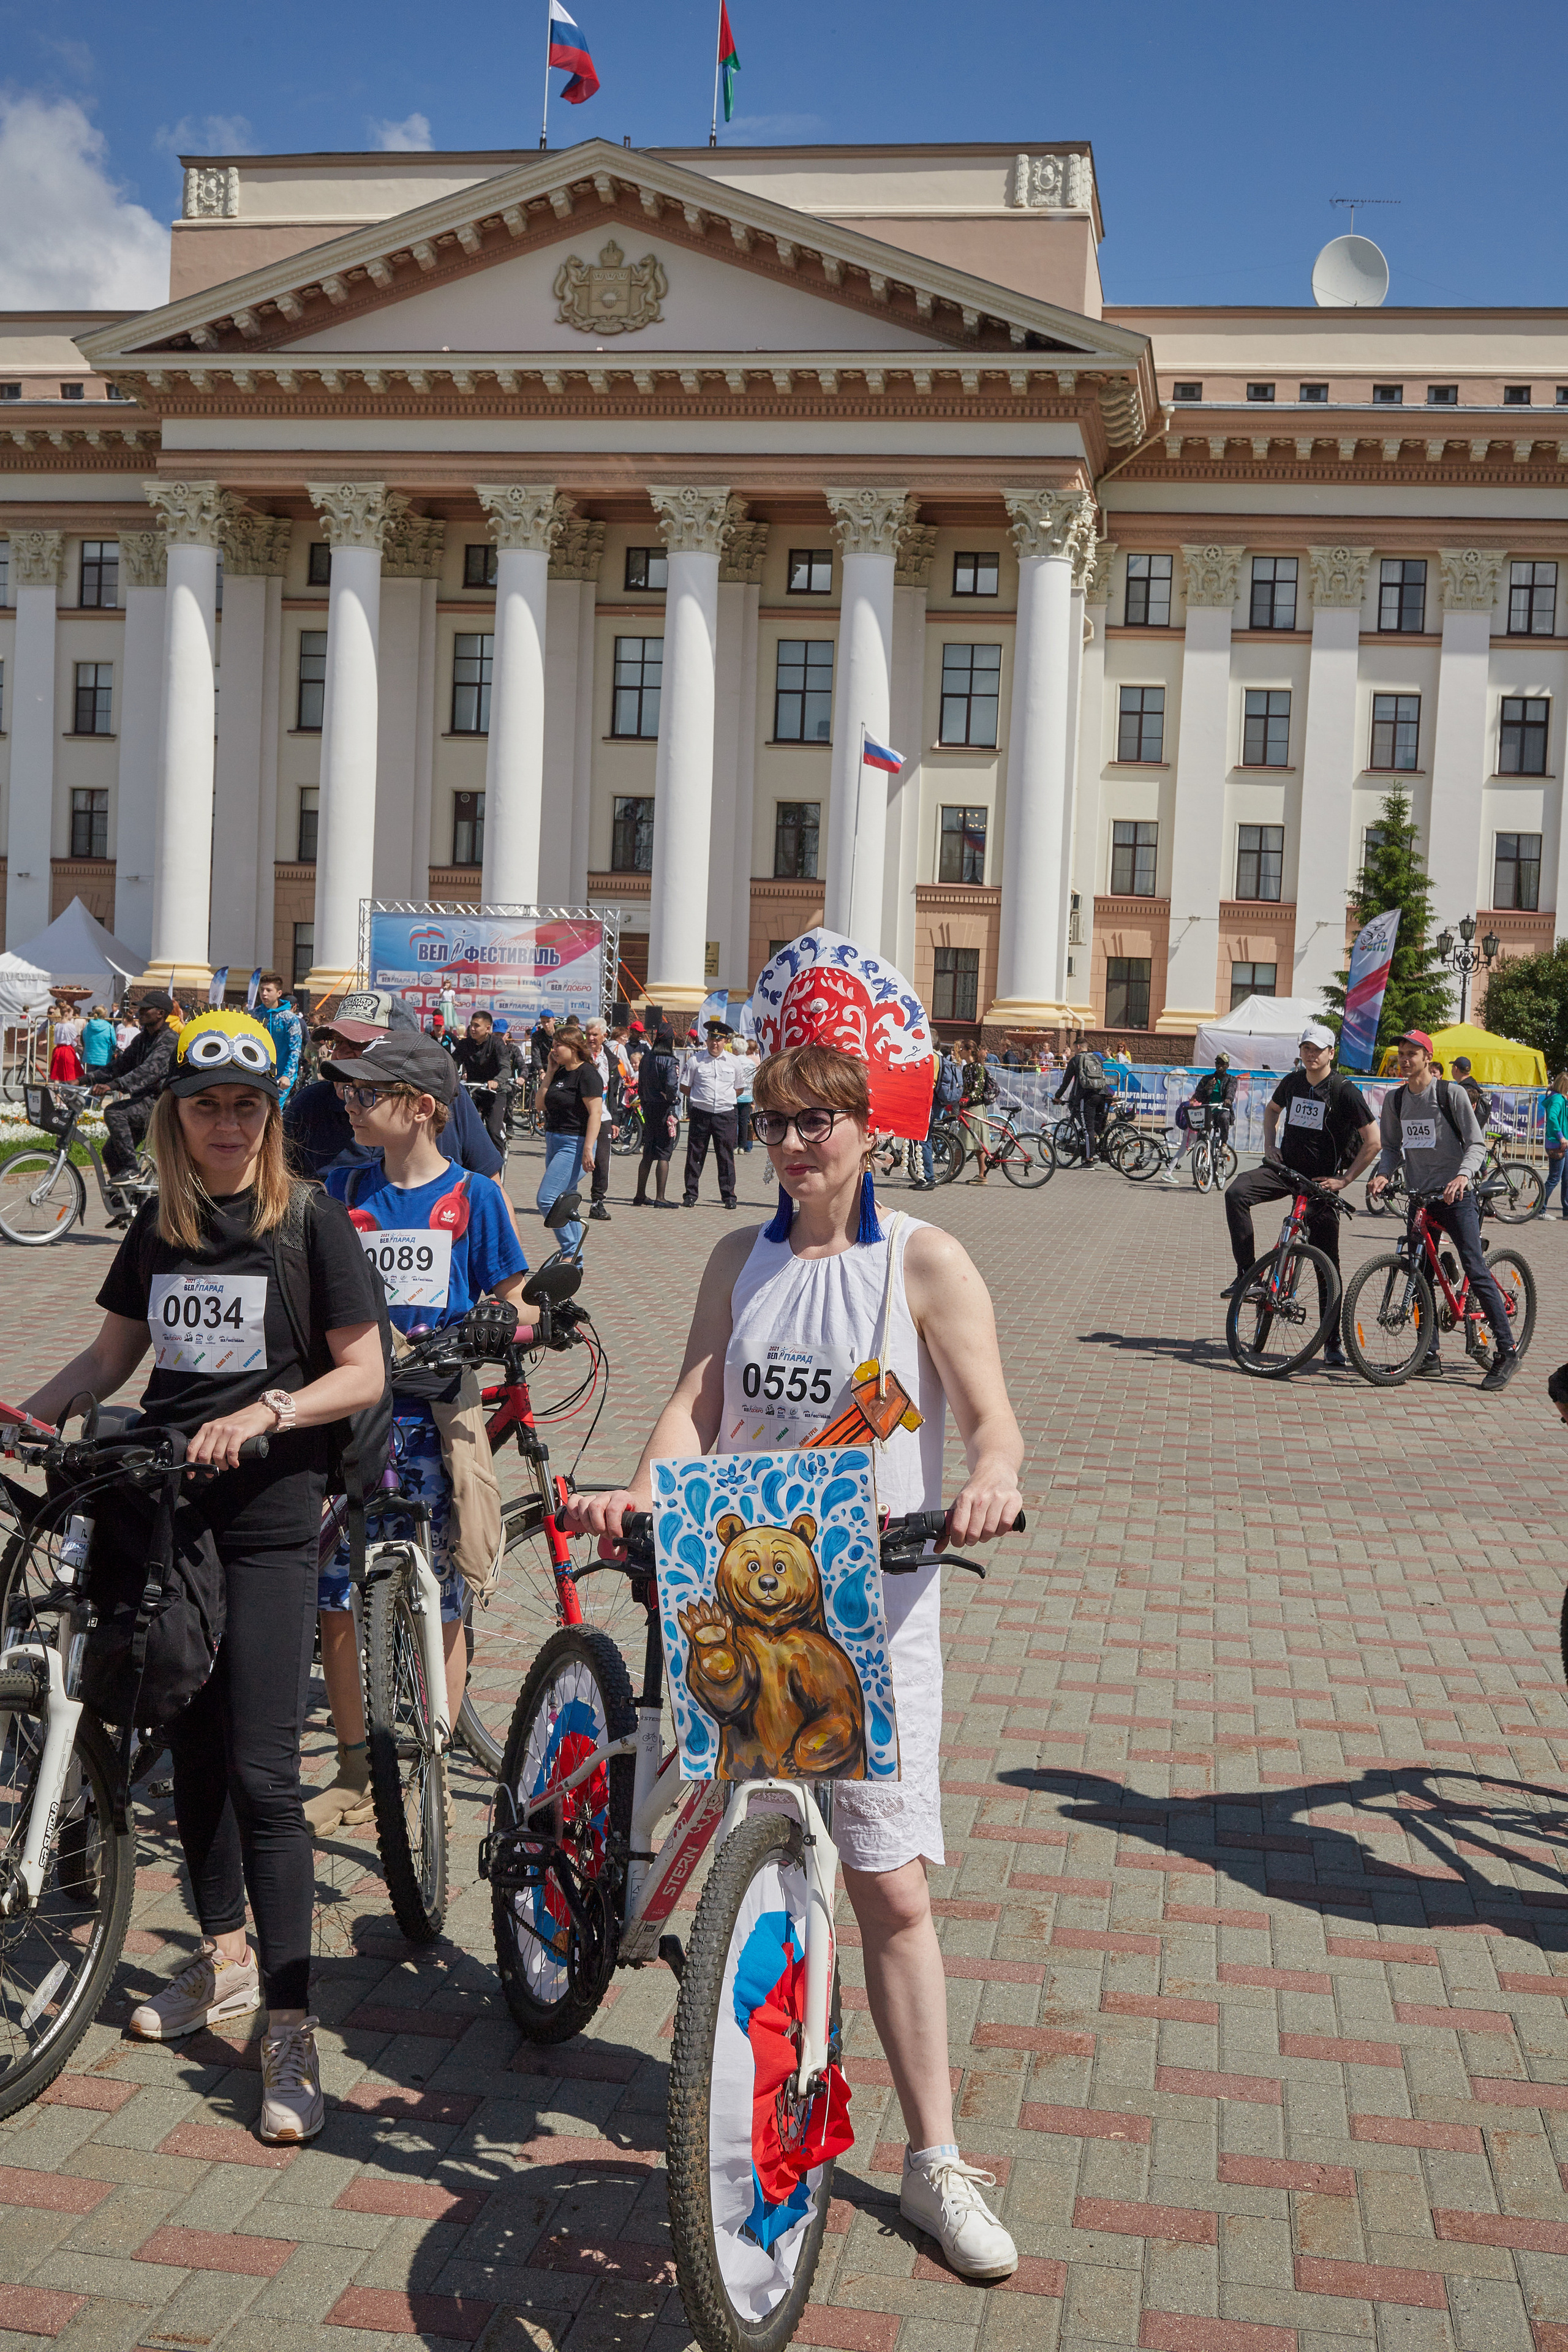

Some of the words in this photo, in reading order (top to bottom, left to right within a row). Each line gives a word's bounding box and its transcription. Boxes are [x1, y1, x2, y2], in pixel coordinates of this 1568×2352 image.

[1295, 1104, 1319, 1117] 0133
[1407, 1126, 1430, 1136] 0245
[407, 1287, 423, 1302] ПАМП-ТРЕК
[429, 1289, 445, 1303] ВИКТОРИНА
[163, 1295, 244, 1329] 0034
[193, 1352, 206, 1365] ЗМЕЙКА
[215, 1350, 234, 1369] ПАМП-ТРЕК
[243, 1349, 262, 1368] ВИКТОРИНА
[401, 1353, 416, 1365] STERN
[742, 1362, 832, 1404] 0555
[775, 1427, 790, 1442] ЗМЕЙКА
[798, 1427, 818, 1447] ПАМП-ТРЕК
[43, 1802, 59, 1849] SUNTOUR
[662, 1845, 700, 1897] STERN
[31, 2001, 75, 2059] ALEXRIMS
